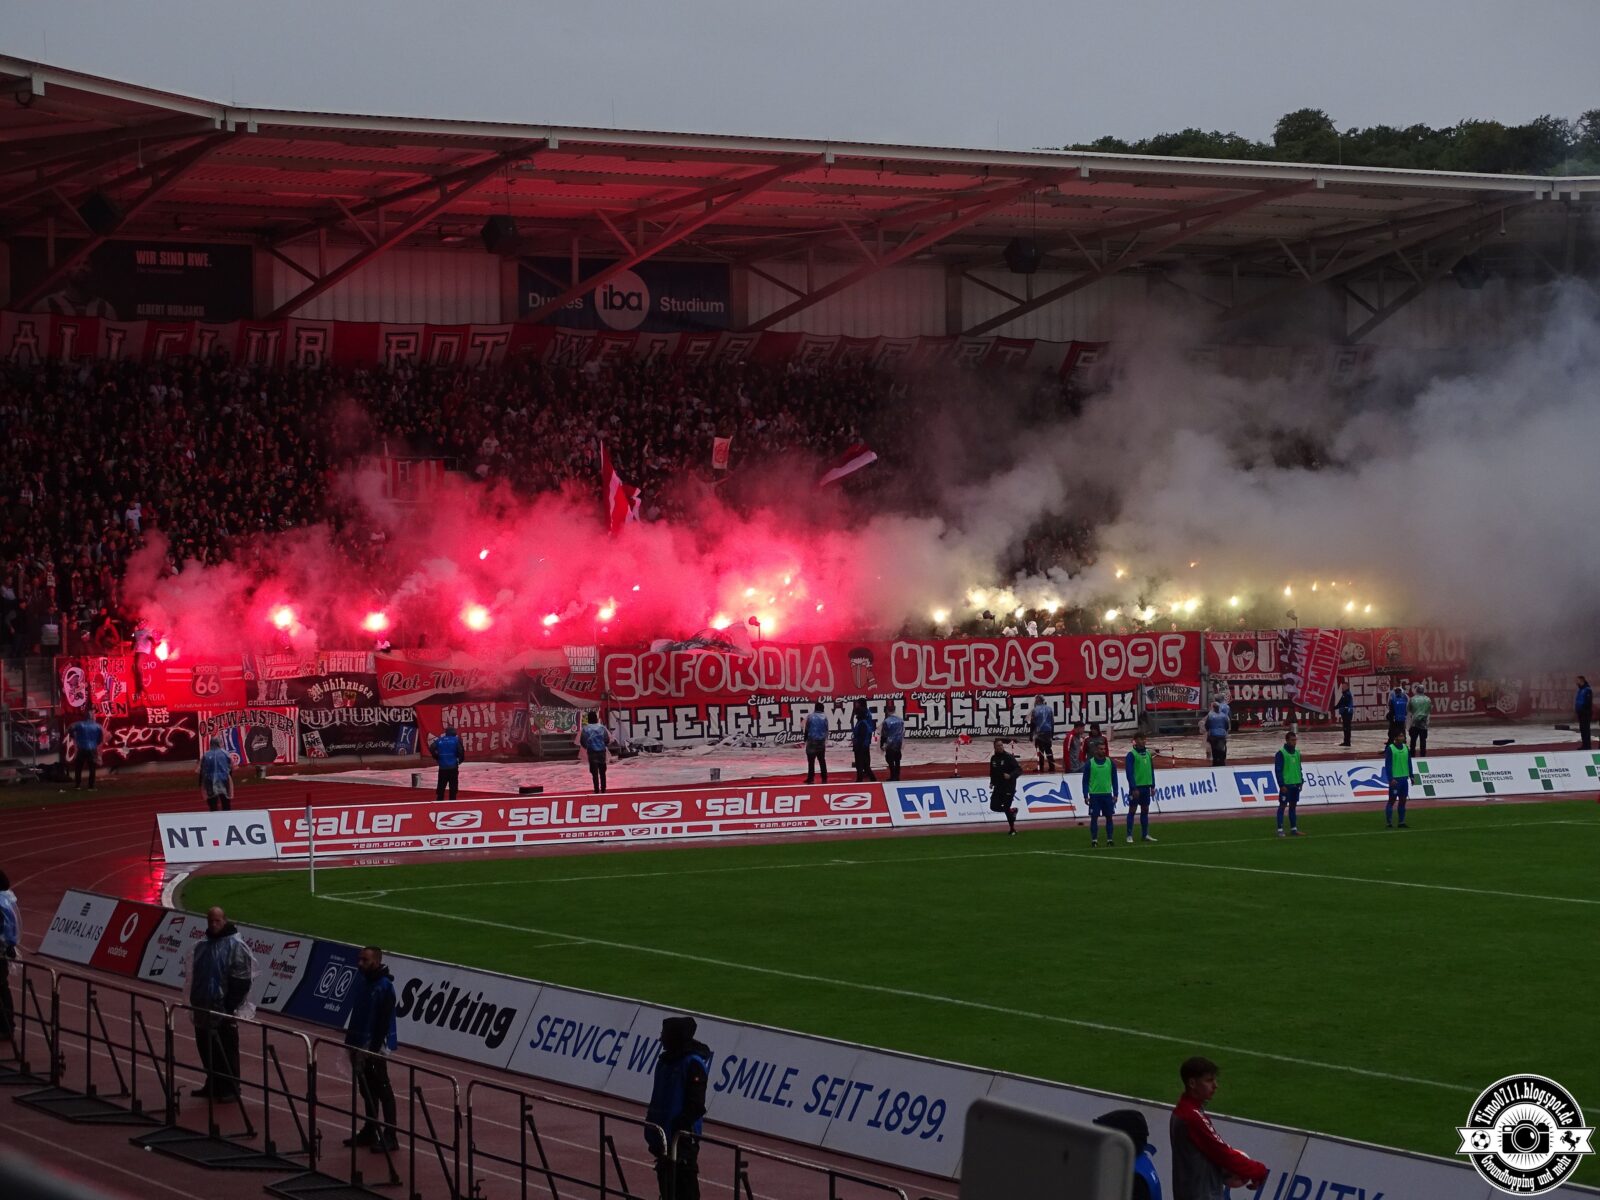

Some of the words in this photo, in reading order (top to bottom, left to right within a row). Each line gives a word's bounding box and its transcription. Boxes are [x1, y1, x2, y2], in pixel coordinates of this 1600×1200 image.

[136, 250, 156, 265] WIR
[160, 252, 184, 266] SIND
[528, 292, 584, 310] Dues
[602, 284, 643, 312] iba
[659, 295, 725, 313] Studium
[195, 665, 218, 673] ROOTS
[329, 657, 366, 672] BERLIN
[604, 645, 834, 700] ERFORDIA
[890, 640, 1060, 690] ULTRAS
[1081, 634, 1186, 681] 1996
[195, 675, 220, 694] 66
[307, 677, 374, 702] Mühlhausen
[382, 671, 420, 692] Rot
[541, 665, 598, 693] Erfurt
[747, 694, 776, 706] Einst
[911, 690, 946, 704] Erfolge
[1234, 684, 1260, 700] LOS
[148, 715, 170, 724] FCC
[441, 703, 497, 729] MAIN
[910, 726, 941, 737] werden
[946, 726, 961, 736] wir
[967, 726, 981, 735] uns
[987, 725, 1009, 737] ewig
[1189, 772, 1218, 796] uns!
[1421, 773, 1453, 781] THÜRINGEN
[508, 800, 619, 827] saller
[705, 791, 811, 817] saller
[294, 811, 414, 838] saller
[166, 823, 267, 849] NT.AG
[51, 916, 103, 942] DOMPALAIS
[107, 945, 129, 959] vodafone
[396, 977, 517, 1051] Stölting
[530, 1014, 629, 1067] SERVICE
[627, 1034, 663, 1075] WI
[713, 1053, 794, 1108] SMILE.
[804, 1073, 865, 1122] SEIT
[867, 1088, 947, 1143] 1899.
